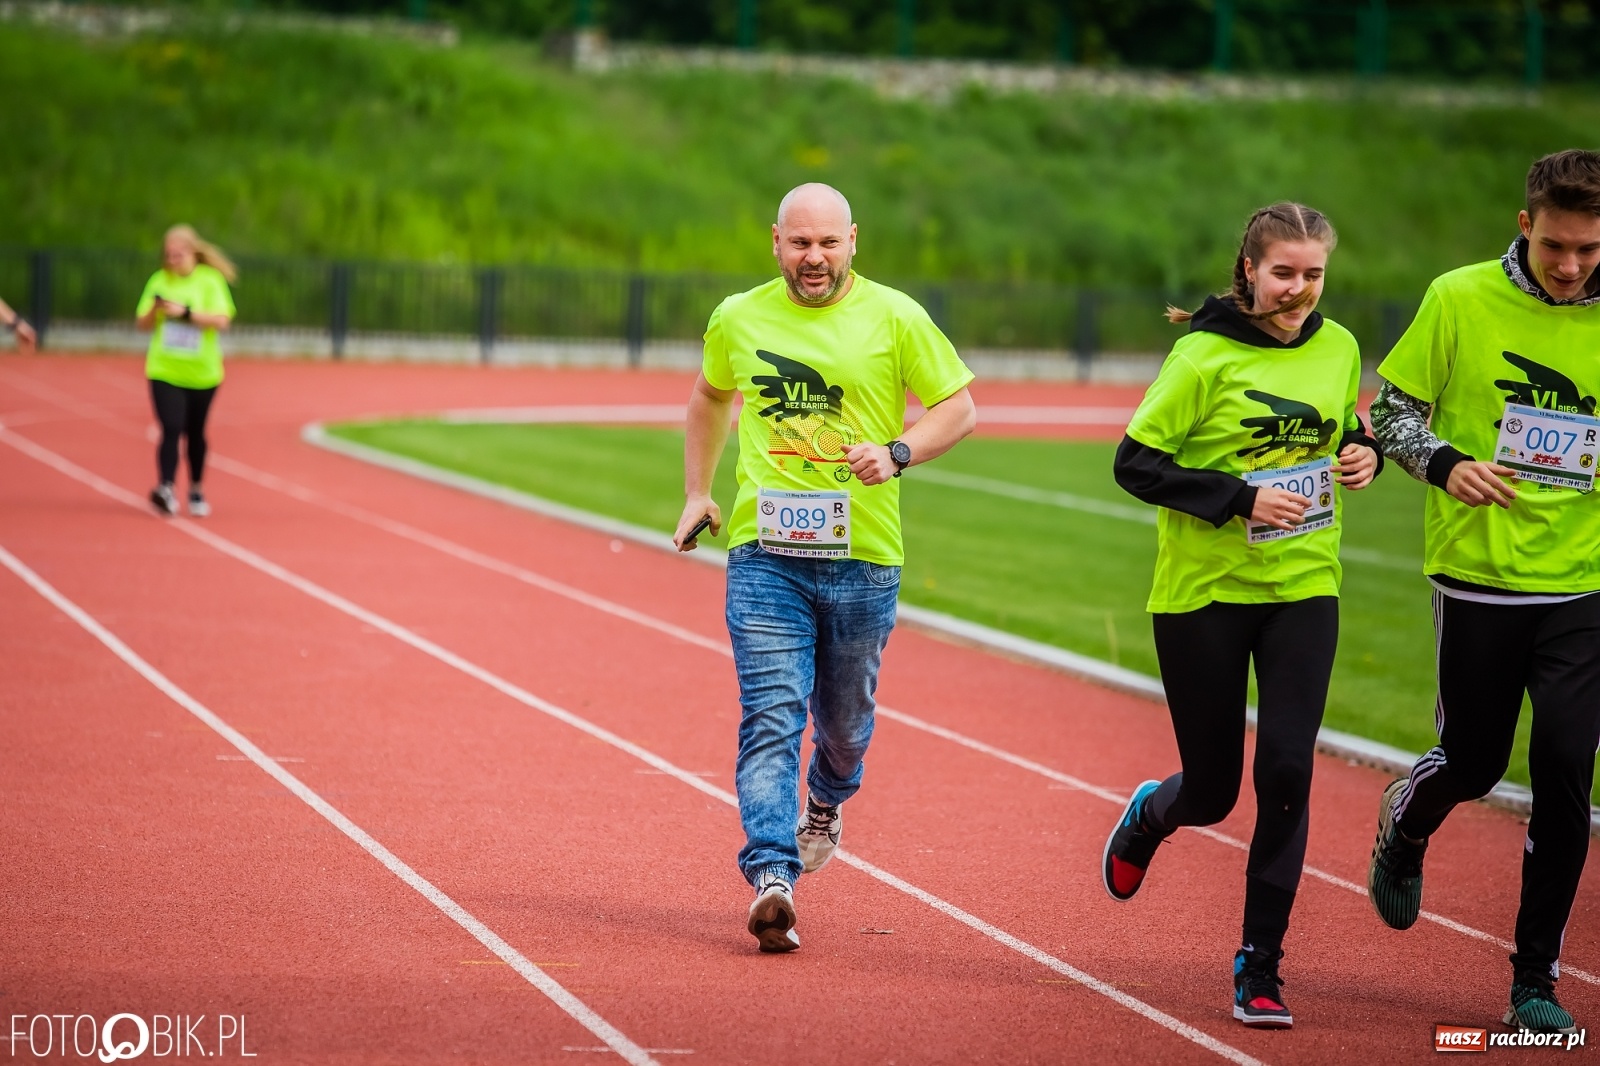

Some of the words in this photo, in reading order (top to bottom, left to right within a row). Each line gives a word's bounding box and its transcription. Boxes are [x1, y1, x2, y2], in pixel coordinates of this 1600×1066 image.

[782, 382, 808, 401] VI
[809, 394, 827, 402] BIEG
[801, 402, 829, 410] BARIER
[1531, 389, 1558, 410] VI
[1558, 404, 1578, 414] BIEG
[1278, 418, 1303, 435] VI
[1299, 428, 1319, 436] BIEG
[1585, 428, 1596, 442] R
[1288, 434, 1319, 445] BARIER
[1525, 426, 1578, 455] 007
[1320, 470, 1329, 484] R
[1271, 475, 1315, 498] 90
[833, 502, 844, 514] R
[780, 507, 826, 530] 089
